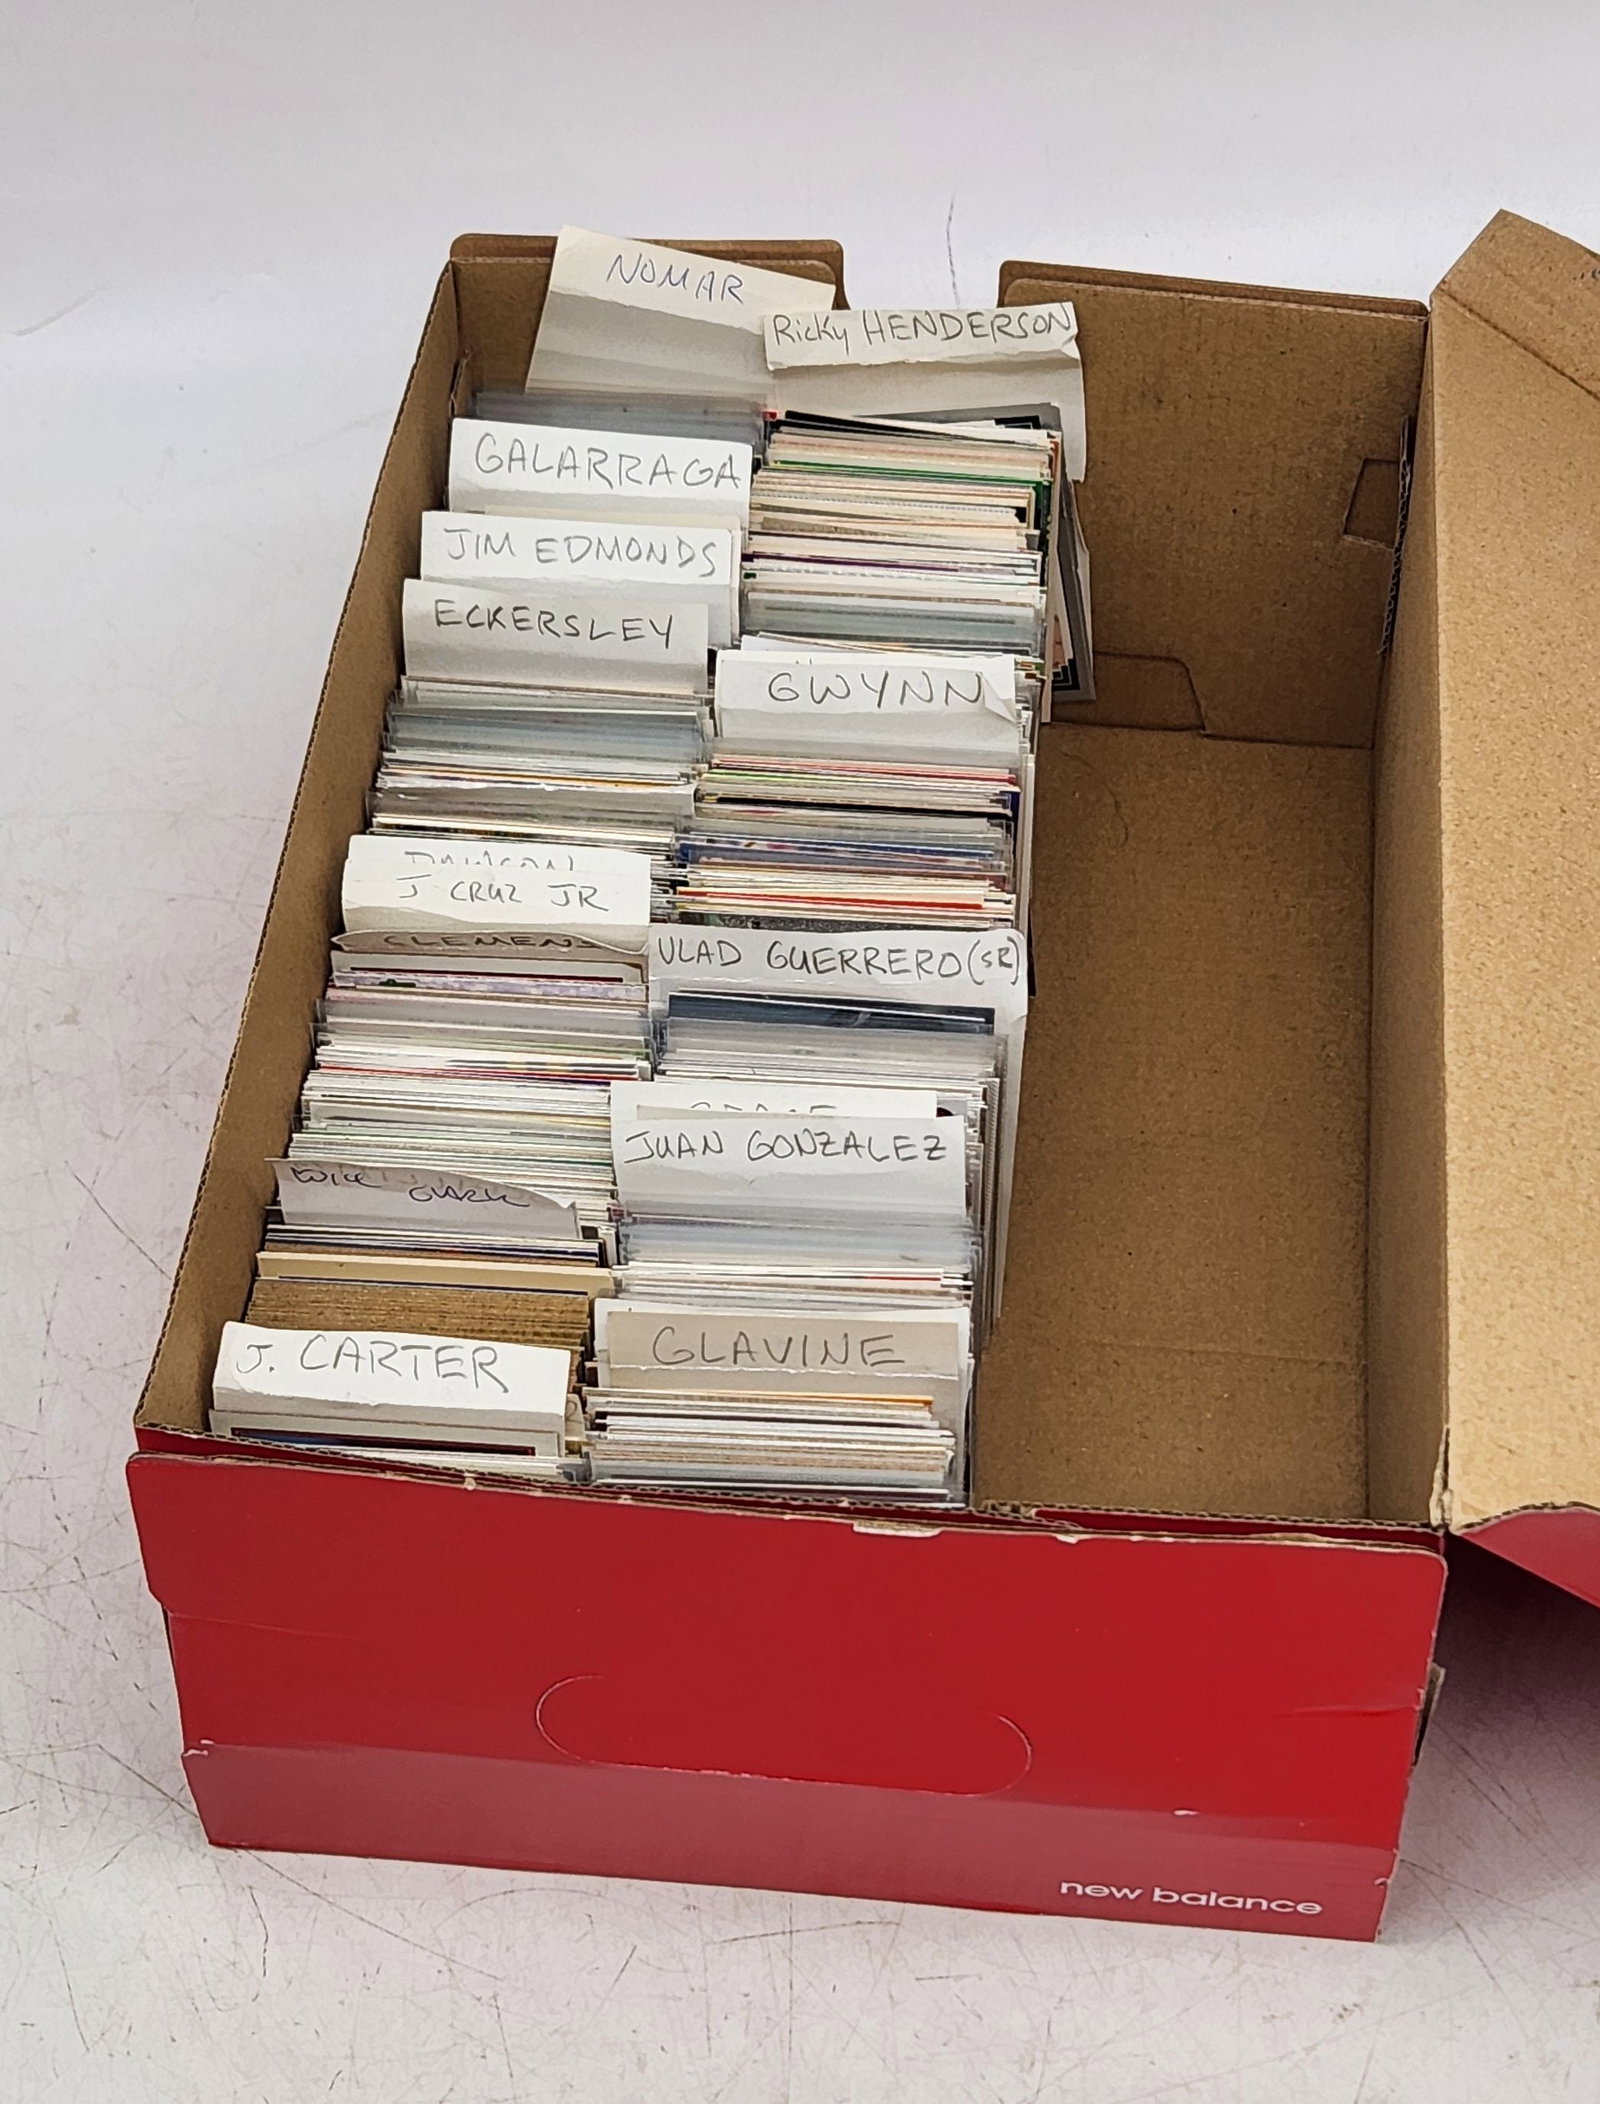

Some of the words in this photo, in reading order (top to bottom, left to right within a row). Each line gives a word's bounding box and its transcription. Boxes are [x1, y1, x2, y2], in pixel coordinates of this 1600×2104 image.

[606, 252, 745, 304] NOMAR
[862, 302, 1072, 345] HENDERSON
[474, 431, 742, 490] GALARRAGA
[443, 528, 516, 560] JIM
[535, 535, 717, 577] EDMONDS
[434, 598, 673, 649] ECKERSLEY
[768, 670, 984, 709] GWYNN
[450, 881, 523, 903] CRUZ
[547, 884, 610, 912] JR
[624, 1129, 723, 1164] JUAN
[747, 1128, 947, 1162] GONZALEZ
[236, 1343, 275, 1375] J.
[299, 1334, 509, 1394] CARTER
[652, 1326, 905, 1366] GLAVINE
[1060, 1881, 1143, 1900] new
[1152, 1886, 1324, 1915] balance
